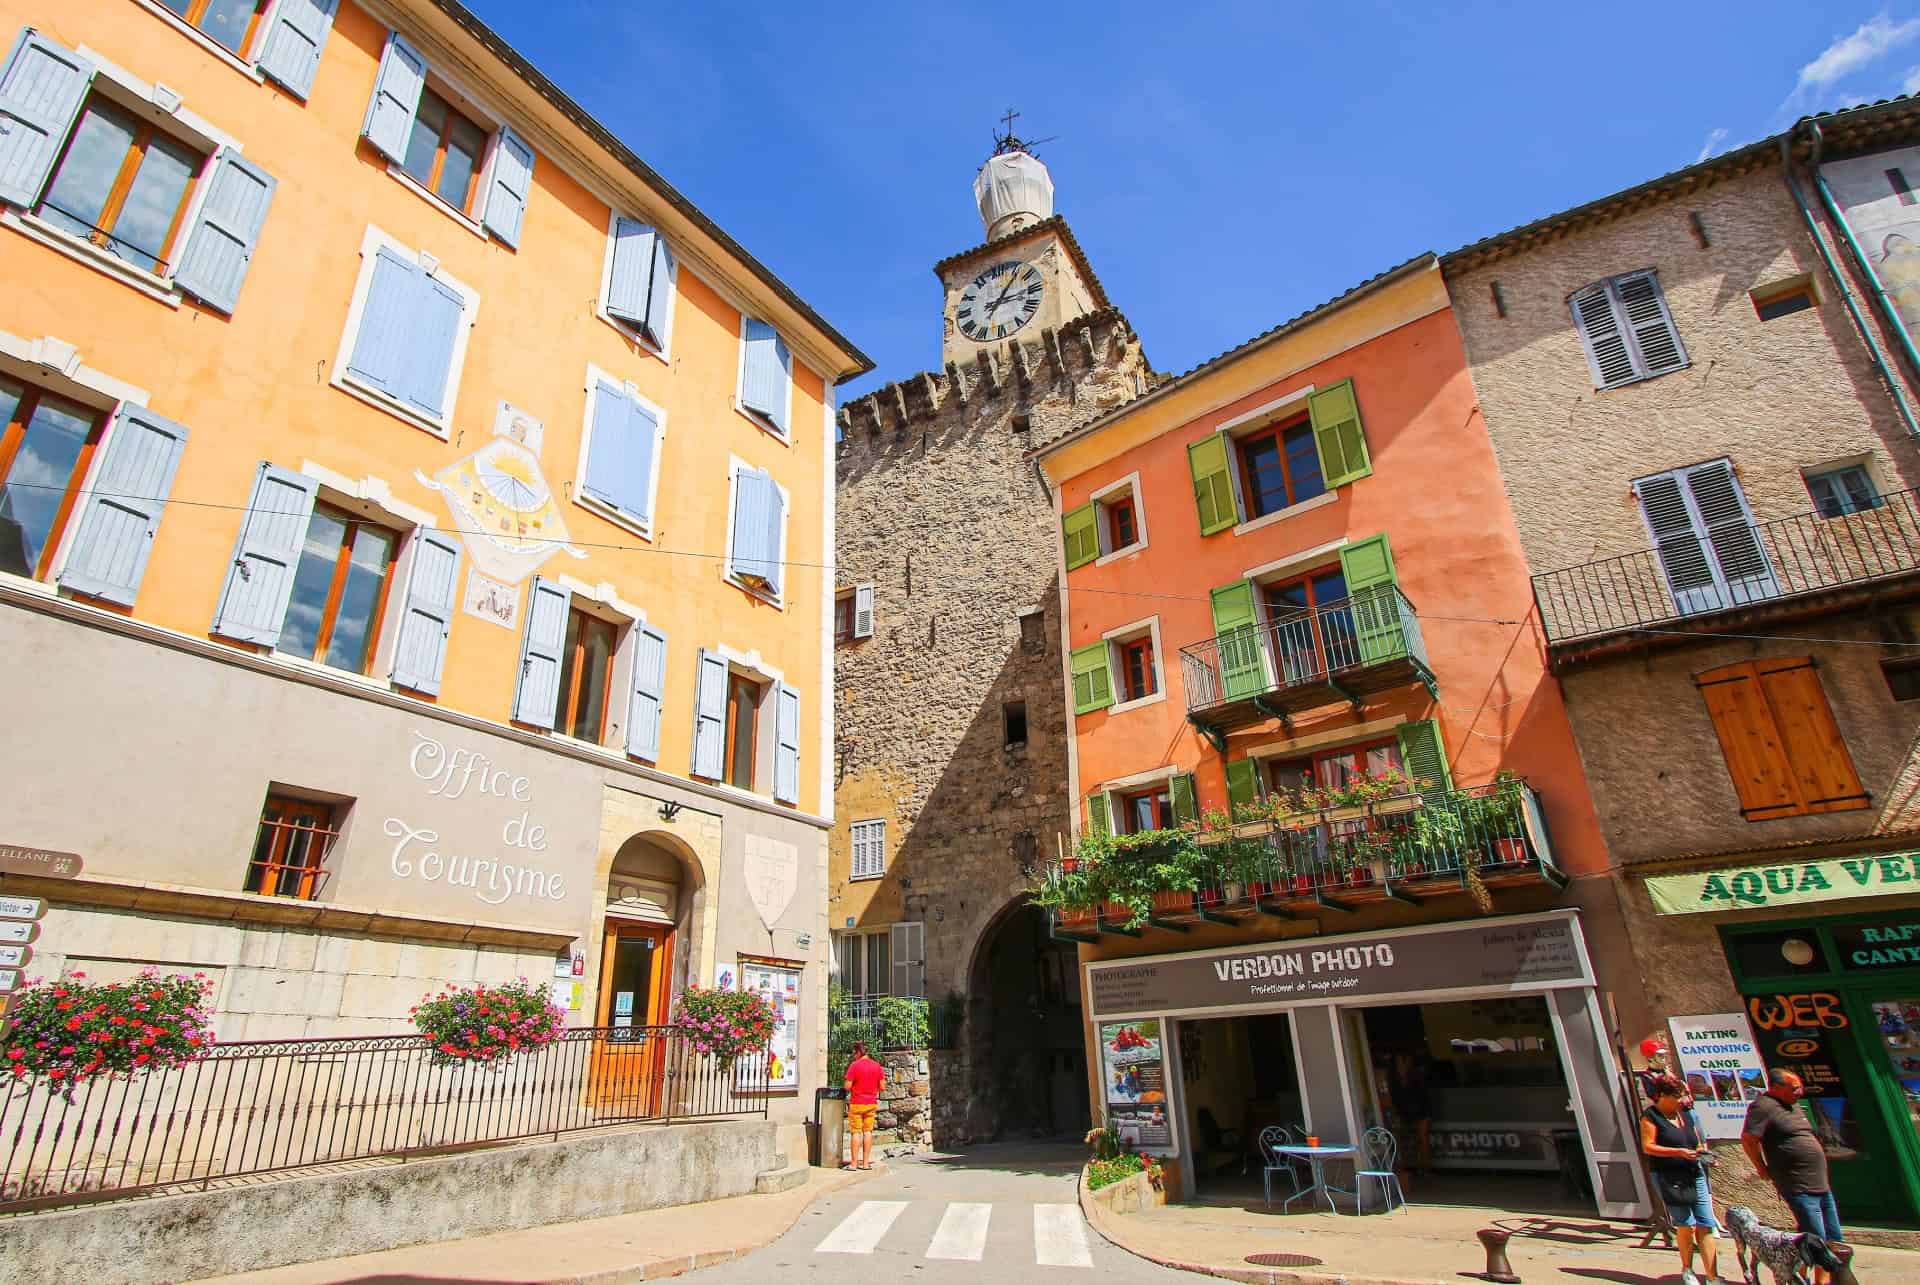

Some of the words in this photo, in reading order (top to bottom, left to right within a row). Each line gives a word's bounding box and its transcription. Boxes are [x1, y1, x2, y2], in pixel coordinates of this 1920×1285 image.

[410, 730, 532, 801] Office
[503, 810, 547, 850] de
[0, 848, 51, 862] ELLANE
[384, 818, 567, 904] Tourisme
[1700, 865, 1833, 904] AQUA
[1214, 953, 1304, 981] VERDON
[1311, 943, 1394, 973] PHOTO
[1296, 981, 1305, 991] de
[1750, 993, 1849, 1031] WEB
[1685, 1029, 1738, 1041] RAFTING
[1700, 1059, 1741, 1068] CANOE
[1450, 1133, 1520, 1149] PHOTO
